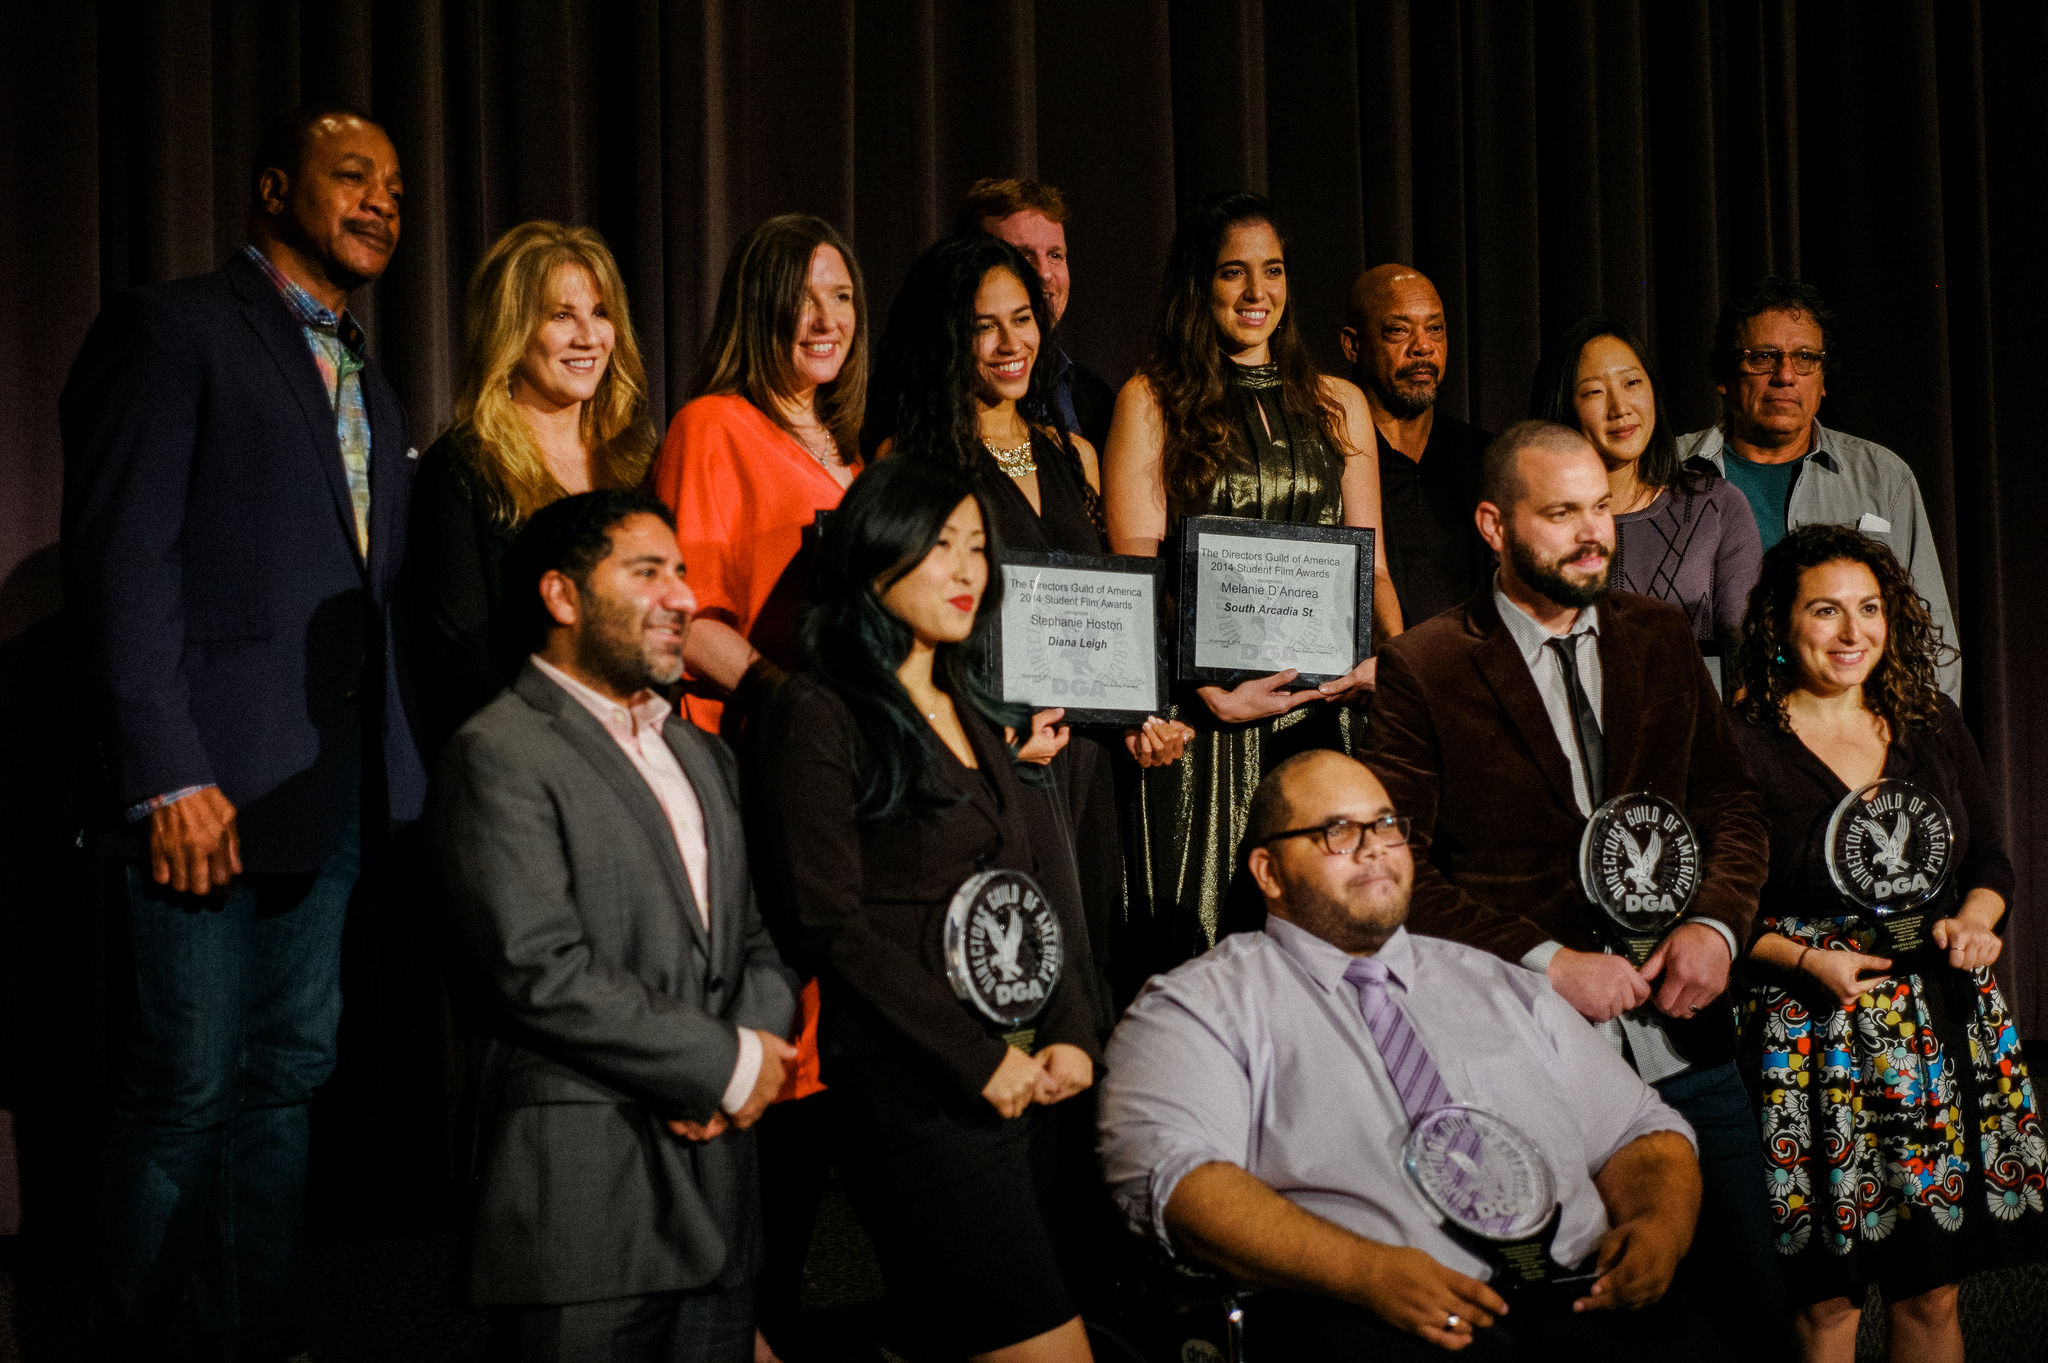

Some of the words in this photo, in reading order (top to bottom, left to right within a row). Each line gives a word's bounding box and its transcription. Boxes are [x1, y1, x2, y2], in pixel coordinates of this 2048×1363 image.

[1201, 548, 1218, 558] The
[1222, 550, 1262, 560] Directors
[1266, 552, 1289, 563] Guild
[1292, 555, 1302, 564] of
[1303, 556, 1340, 566] America
[1211, 562, 1234, 572] 2014
[1237, 564, 1272, 574] Student
[1274, 566, 1294, 576] Film
[1296, 568, 1330, 578] Awards
[1010, 578, 1027, 588] The
[1071, 582, 1094, 594] Guild
[1096, 586, 1106, 594] of
[1107, 586, 1142, 597] America
[1222, 582, 1264, 595] Melanie
[1268, 586, 1319, 598] D'Andrea
[1044, 595, 1078, 606] Student
[1080, 597, 1099, 608] Film
[1100, 599, 1133, 610] Awards
[1224, 602, 1256, 614] South
[1258, 604, 1298, 616] Arcadia
[1302, 607, 1315, 618] St.
[1031, 614, 1083, 628] Stephanie
[1086, 618, 1123, 630] Hoston
[1048, 636, 1076, 648] Diana
[1080, 638, 1108, 650] Leigh
[1845, 815, 1874, 890] DIRECTORS
[1865, 793, 1902, 818] GUILD
[1908, 796, 1928, 815] OF
[1922, 812, 1946, 874] AMERICA
[1602, 820, 1626, 900] DIRECTORS
[1624, 805, 1660, 827] GUILD
[1663, 813, 1681, 832] OF
[1672, 834, 1694, 899] AMERICA
[1874, 872, 1930, 899] DGA
[1625, 894, 1676, 912] DGA
[995, 978, 1045, 1006] DGA
